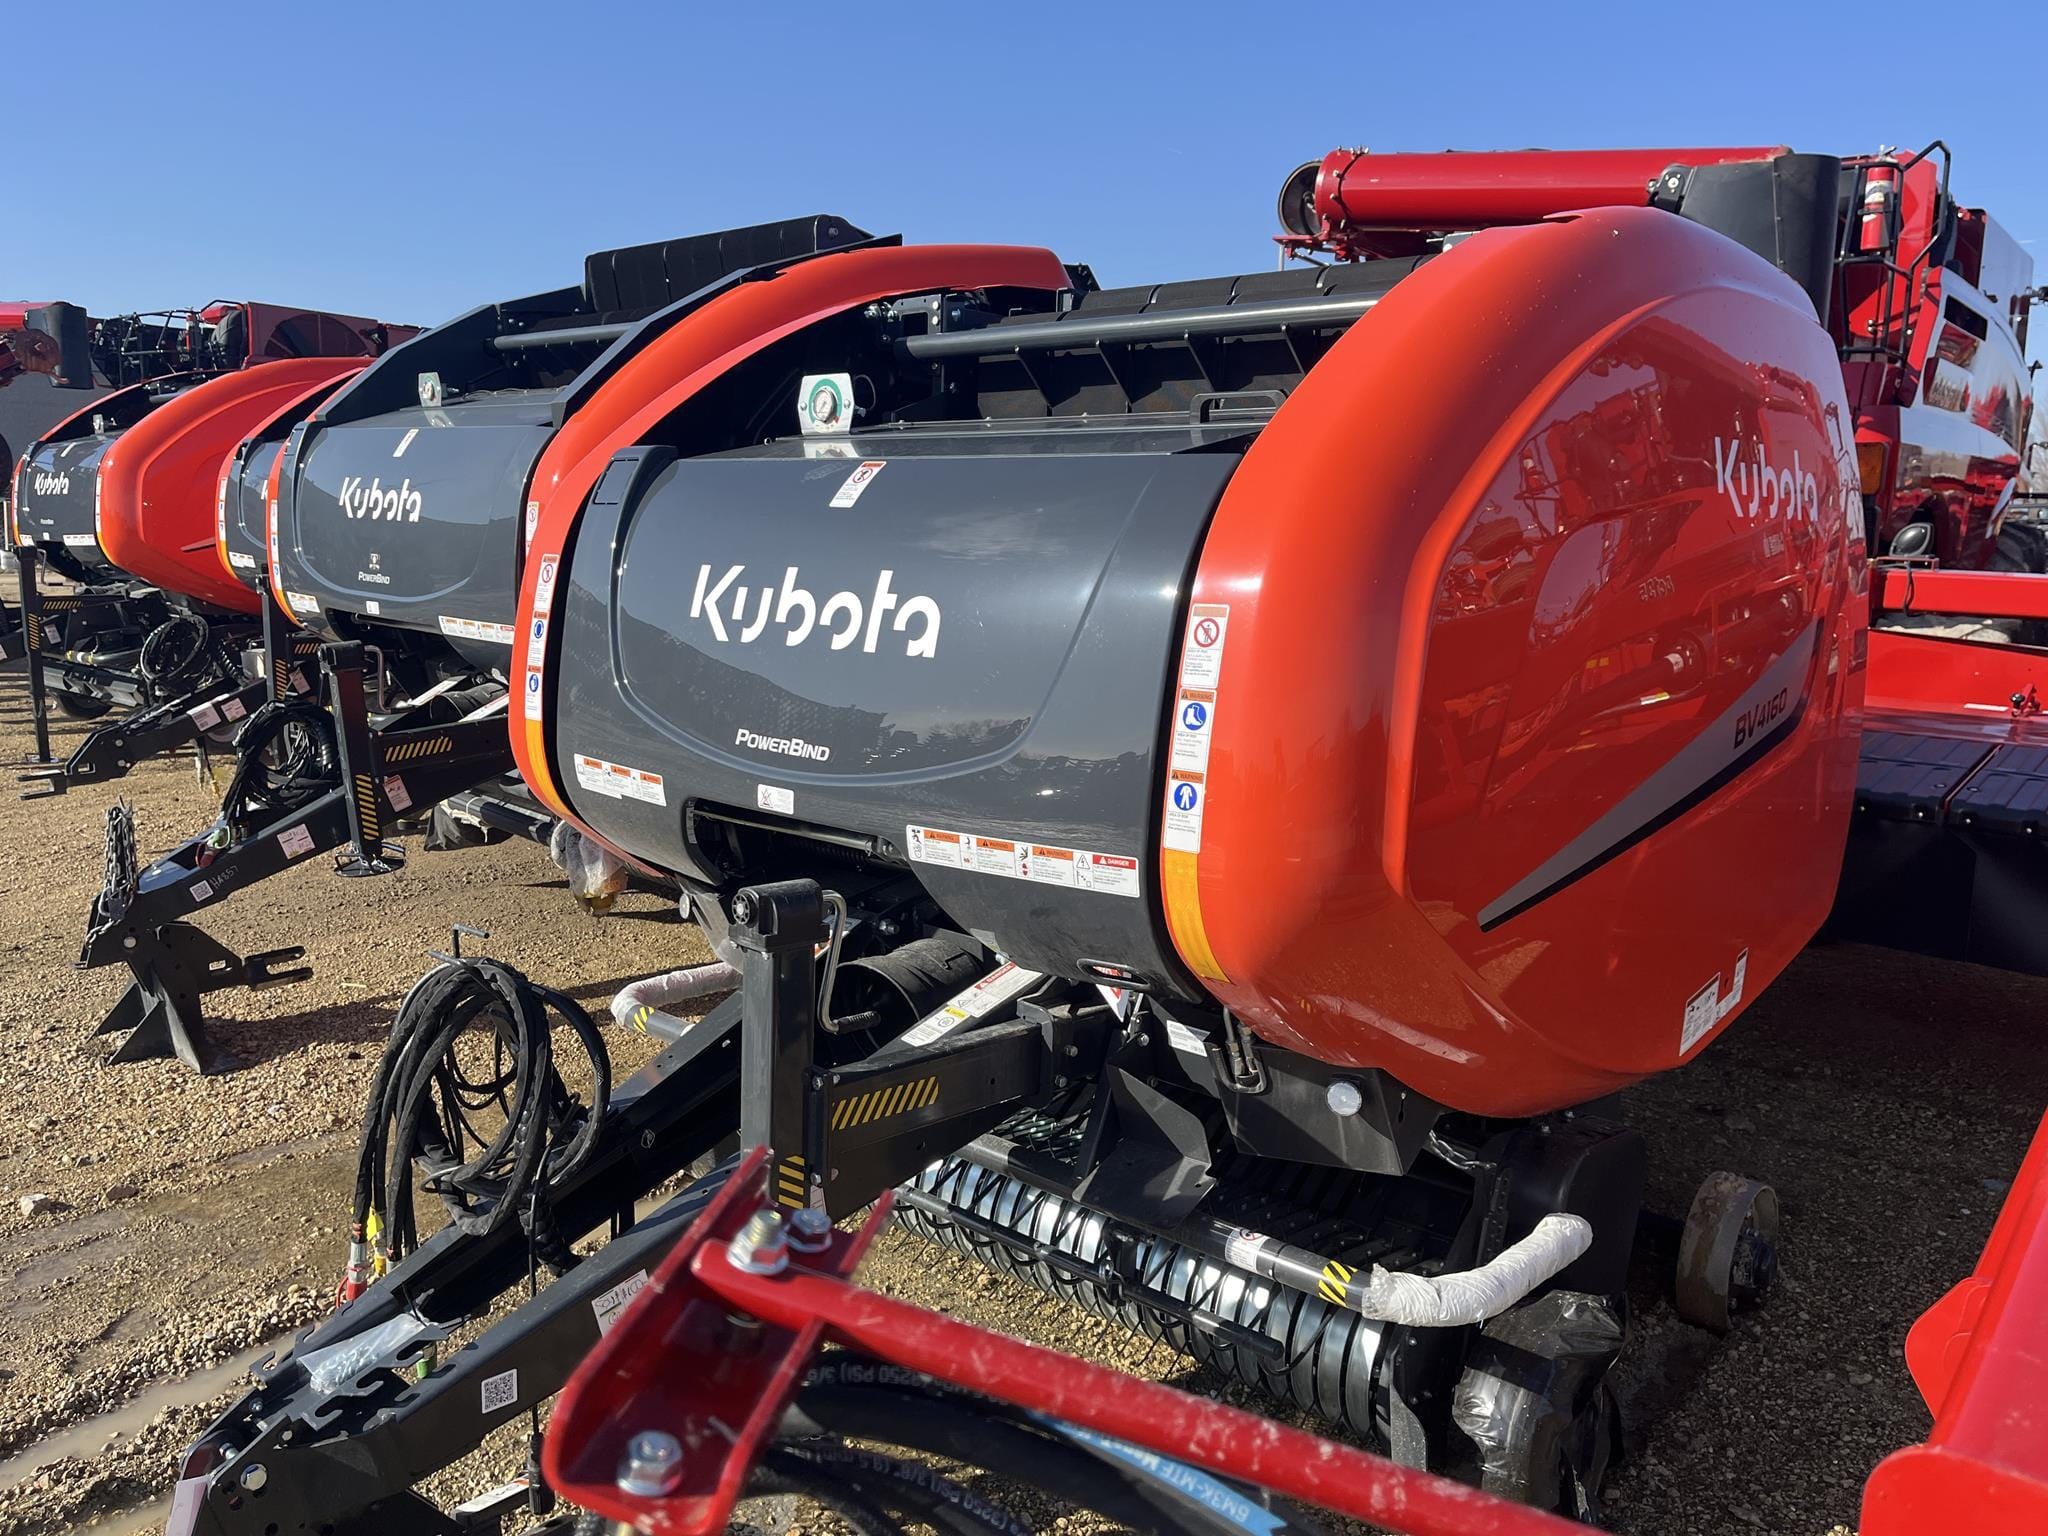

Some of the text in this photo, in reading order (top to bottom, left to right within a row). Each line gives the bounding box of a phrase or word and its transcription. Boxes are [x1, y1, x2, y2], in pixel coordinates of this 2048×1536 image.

[35, 472, 69, 495] Kubota
[339, 477, 421, 522] Kubota
[1715, 437, 1818, 521] Kubota
[690, 565, 941, 658] Kubota
[1734, 688, 1787, 749] BV4160
[1107, 858, 1129, 867] DANGER
[1160, 1463, 1251, 1522] 6M3K-MTF
